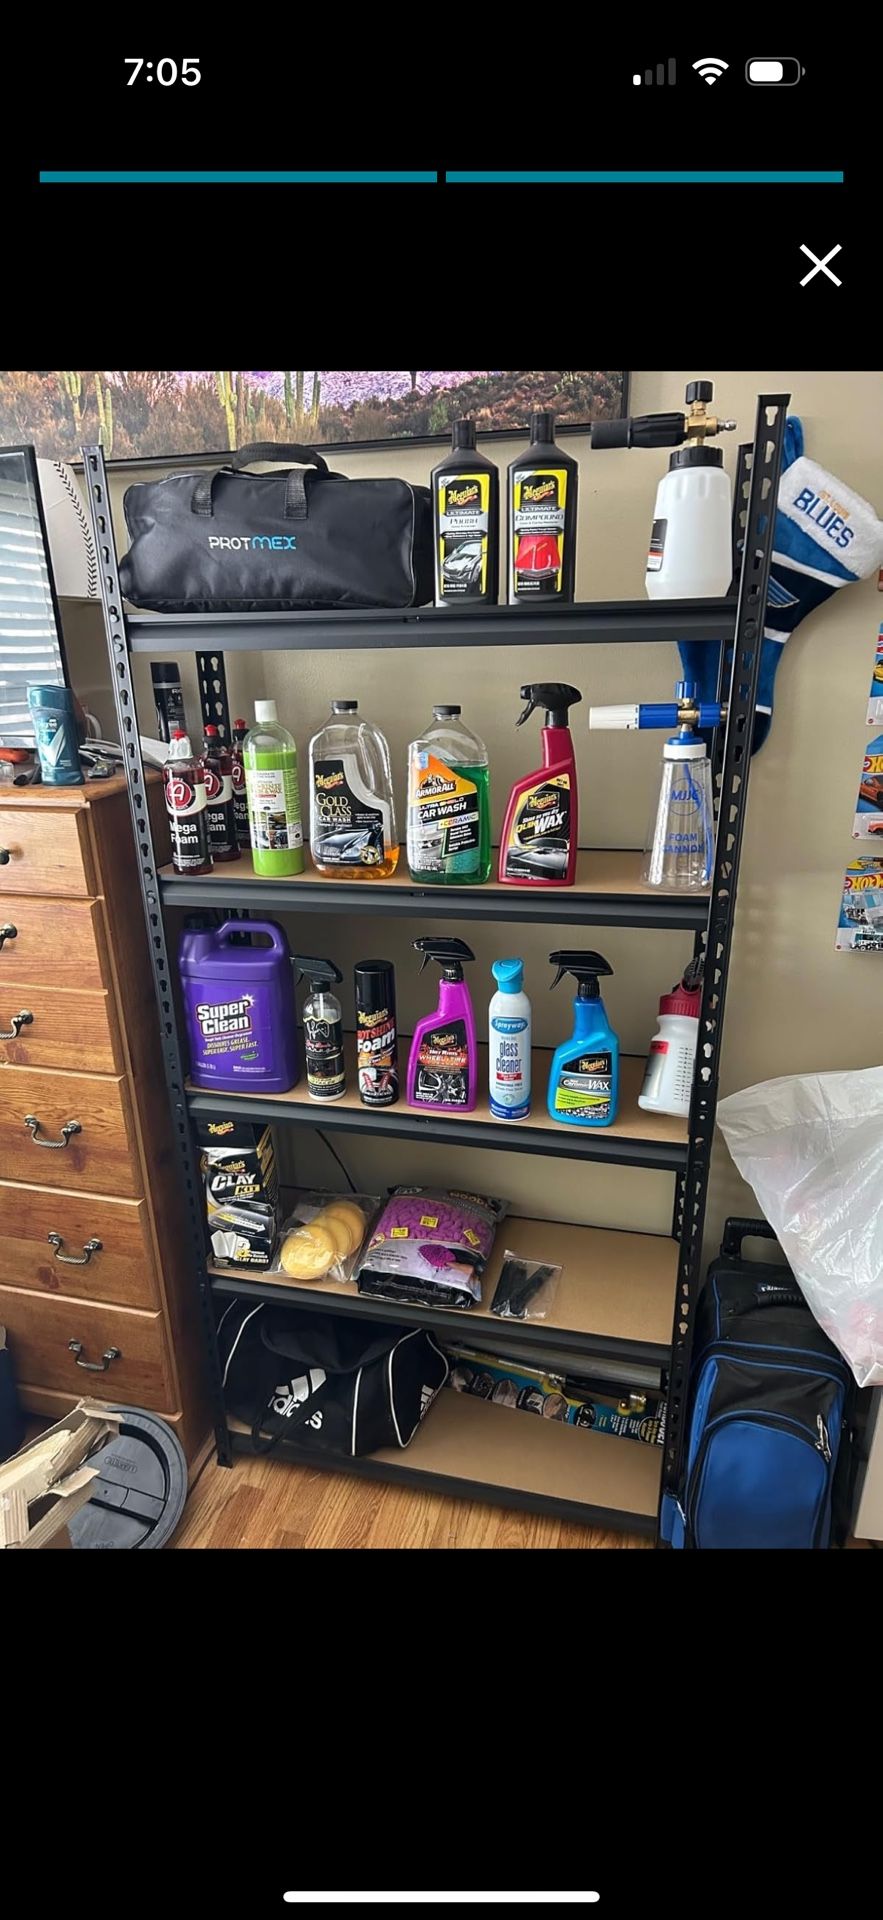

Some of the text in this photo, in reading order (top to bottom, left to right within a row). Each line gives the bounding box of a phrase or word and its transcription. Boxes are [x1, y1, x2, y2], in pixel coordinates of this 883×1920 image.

[793, 487, 854, 549] BLUES
[208, 536, 297, 551] PROTMEX
[208, 812, 224, 823] ega
[418, 802, 467, 819] CAR WASH
[534, 811, 565, 835] WAX
[669, 833, 697, 842] FOAM
[197, 1001, 249, 1020] Super
[202, 1016, 249, 1035] Clean
[358, 1028, 395, 1052] Foam
[500, 1041, 518, 1058] glass
[496, 1057, 522, 1073] cleaner
[210, 1173, 256, 1191] CLAY
[238, 1185, 258, 1193] KIT
